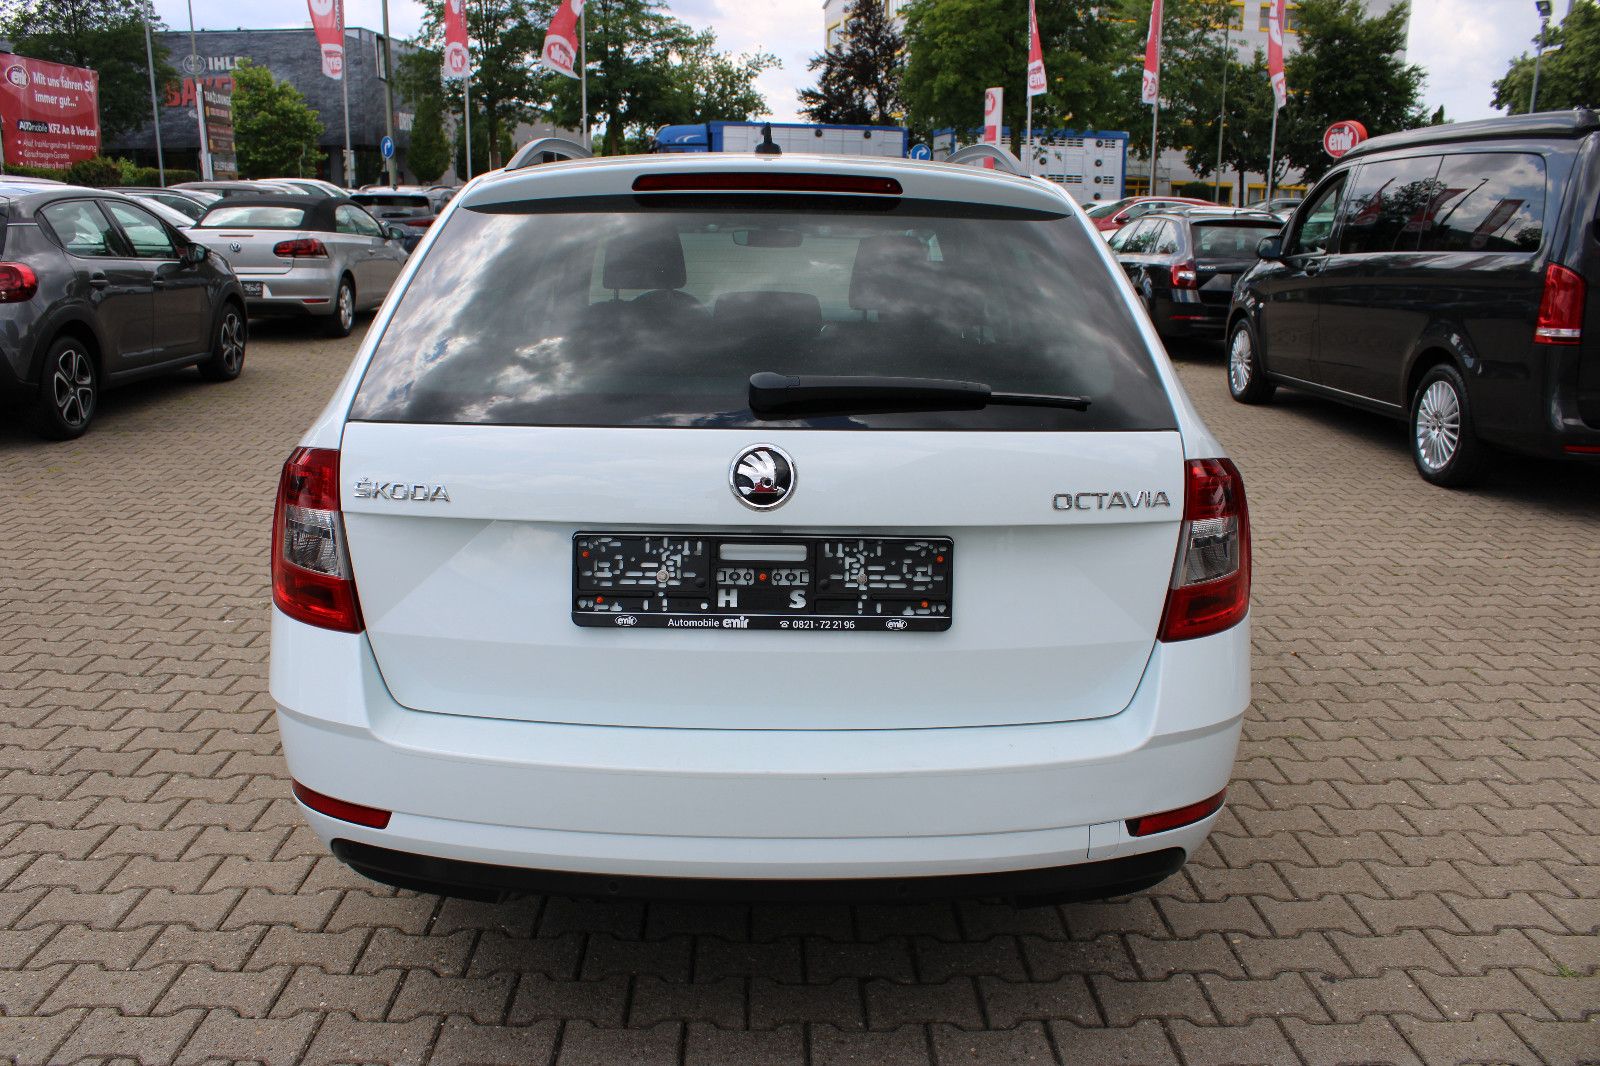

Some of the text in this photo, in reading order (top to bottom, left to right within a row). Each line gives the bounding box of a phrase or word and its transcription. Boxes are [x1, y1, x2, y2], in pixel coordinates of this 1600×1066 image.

[33, 71, 46, 85] Mit
[47, 77, 60, 88] uns
[61, 76, 83, 91] fahren
[34, 89, 58, 105] immer
[48, 123, 61, 134] KFZ
[62, 125, 70, 135] An
[70, 125, 76, 135] &
[1053, 490, 1171, 511] OCTAVIA
[667, 615, 750, 629] Automobile emir
